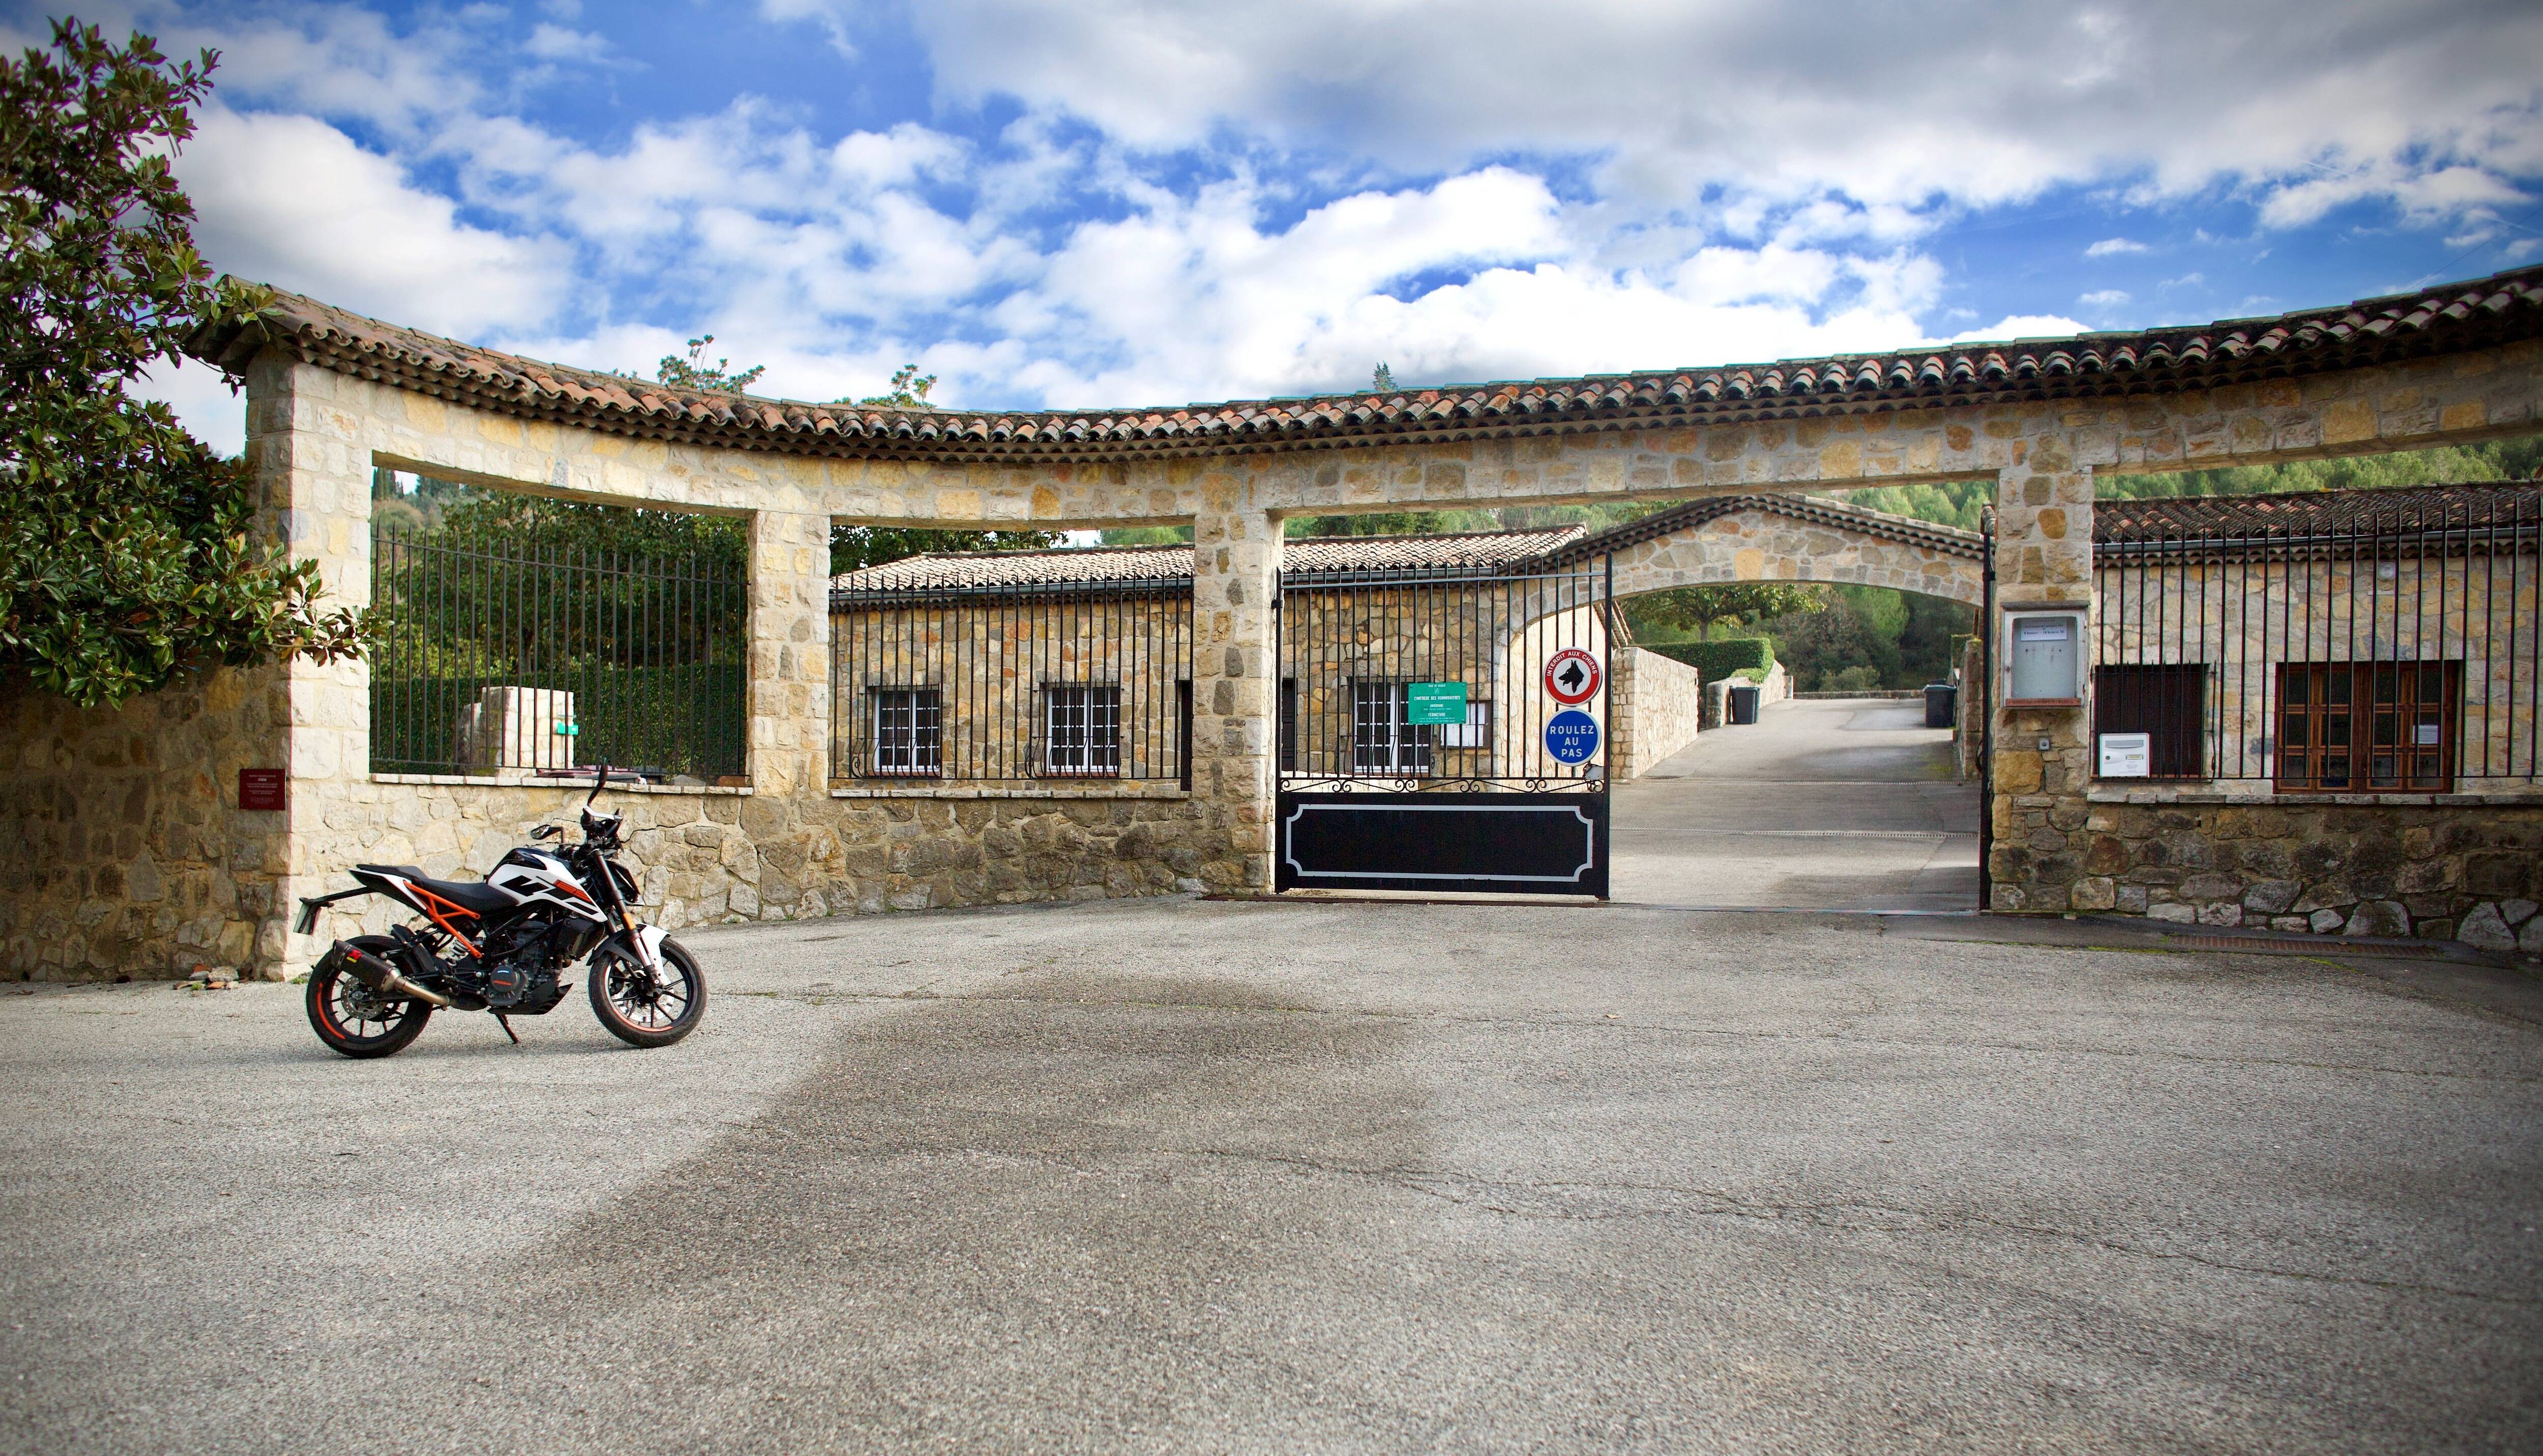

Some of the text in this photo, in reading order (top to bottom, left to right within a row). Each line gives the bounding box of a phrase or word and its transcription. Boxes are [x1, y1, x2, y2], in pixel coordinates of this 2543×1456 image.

[1546, 652, 1565, 676] INTERDIT
[1582, 654, 1598, 674] CHIENS
[1550, 725, 1594, 735] ROULEZ
[1564, 737, 1579, 746] AU
[1561, 748, 1583, 757] PAS
